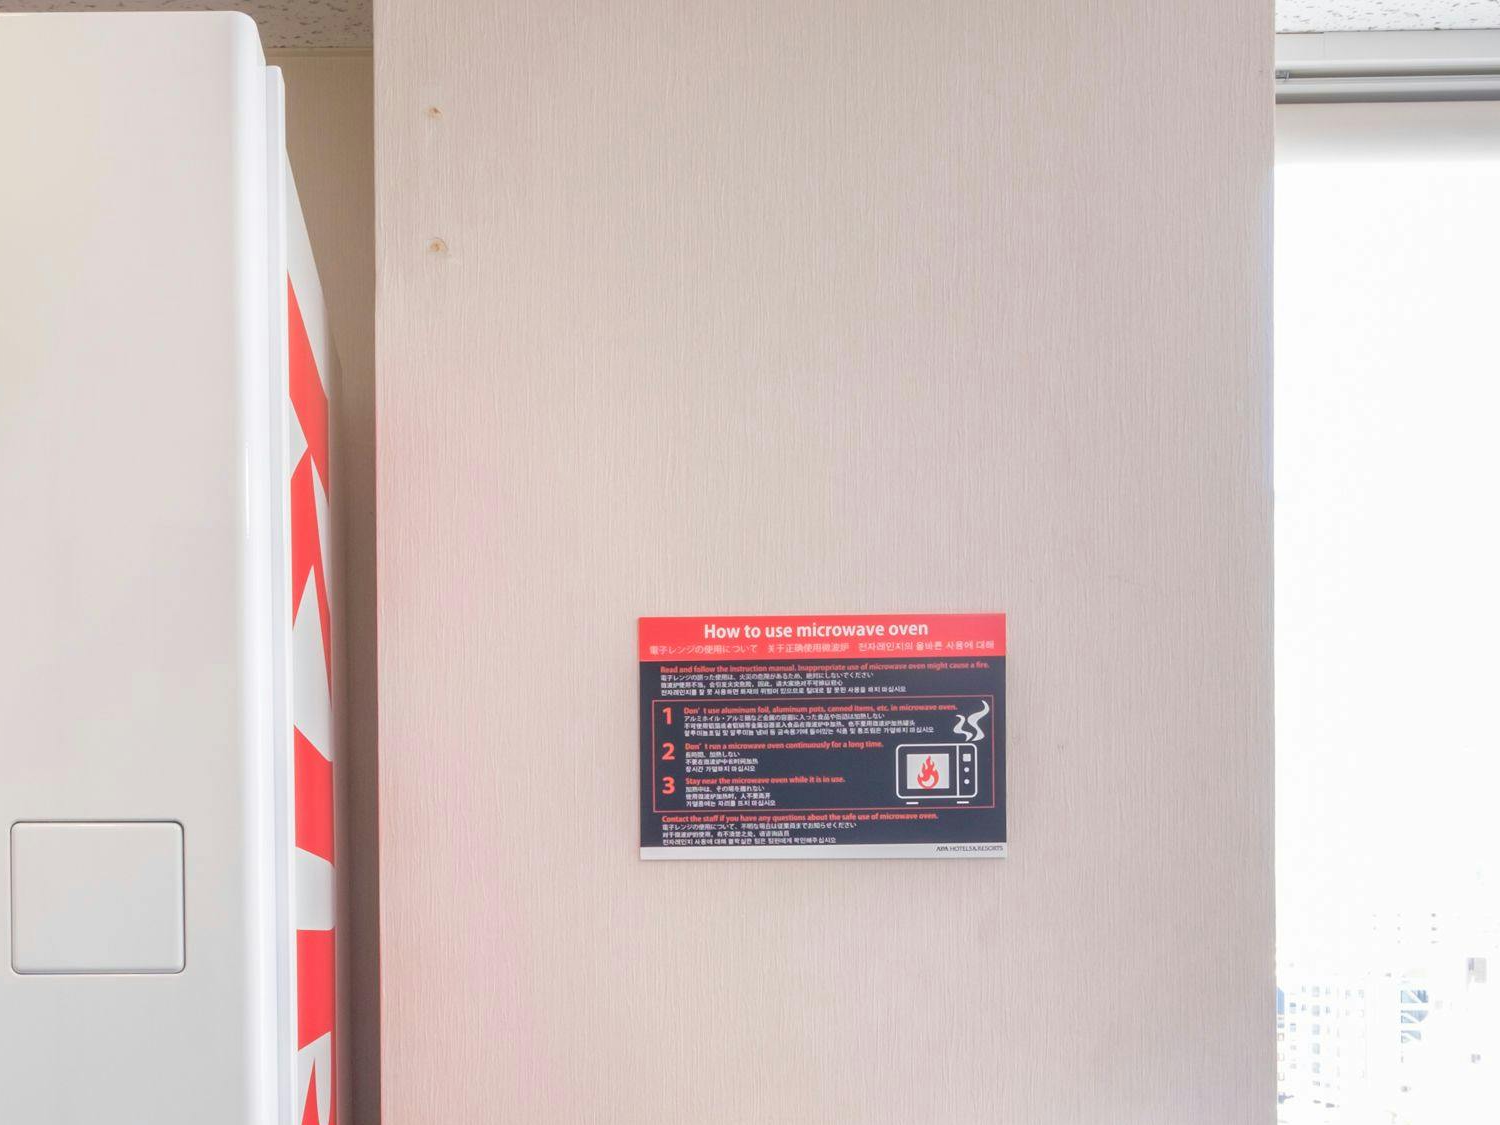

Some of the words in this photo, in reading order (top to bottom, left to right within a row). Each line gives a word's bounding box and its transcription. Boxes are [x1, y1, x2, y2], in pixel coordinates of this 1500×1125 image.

[704, 624, 740, 638] How
[744, 625, 761, 638] to
[765, 626, 792, 638] use
[797, 623, 884, 637] microwave
[889, 623, 928, 636] oven
[662, 707, 672, 725] 1
[662, 742, 675, 760] 2
[662, 777, 675, 794] 3
